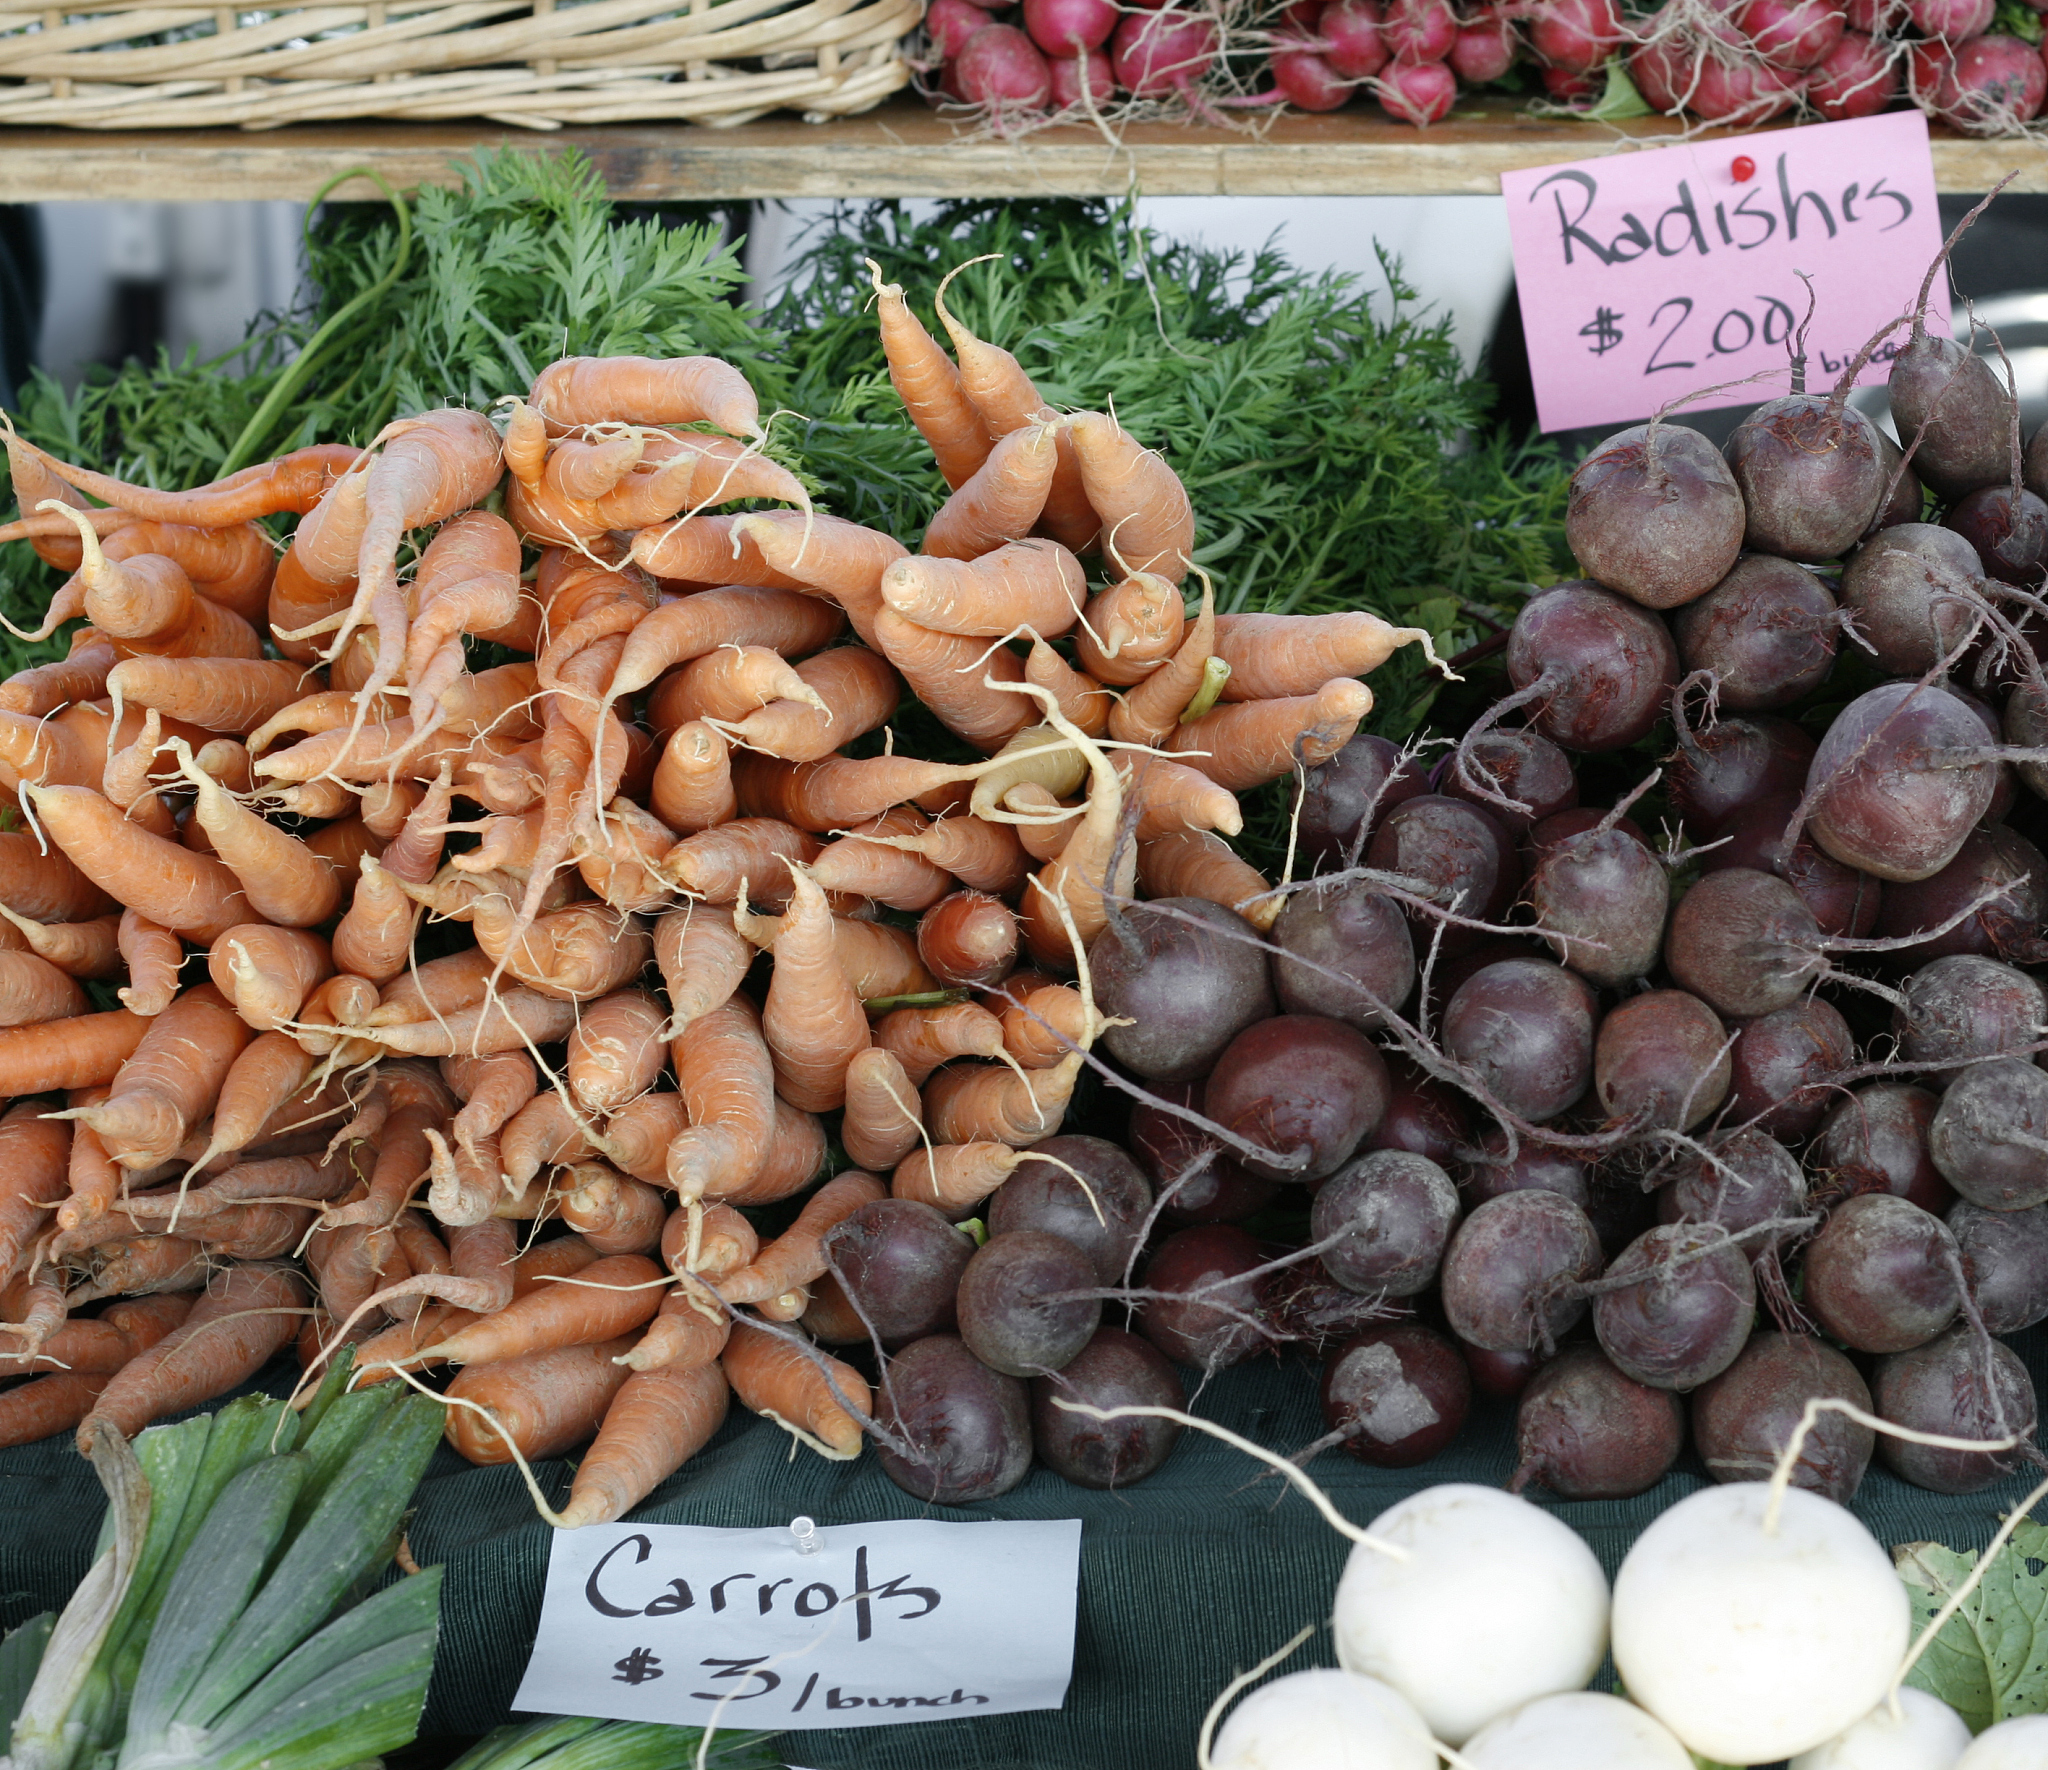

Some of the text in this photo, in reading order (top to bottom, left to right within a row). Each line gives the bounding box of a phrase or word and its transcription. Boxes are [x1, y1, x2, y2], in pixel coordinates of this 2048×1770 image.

[1530, 152, 1913, 266] Radishes
[1819, 341, 1898, 373] buc
[585, 1534, 941, 1641] Carrots
